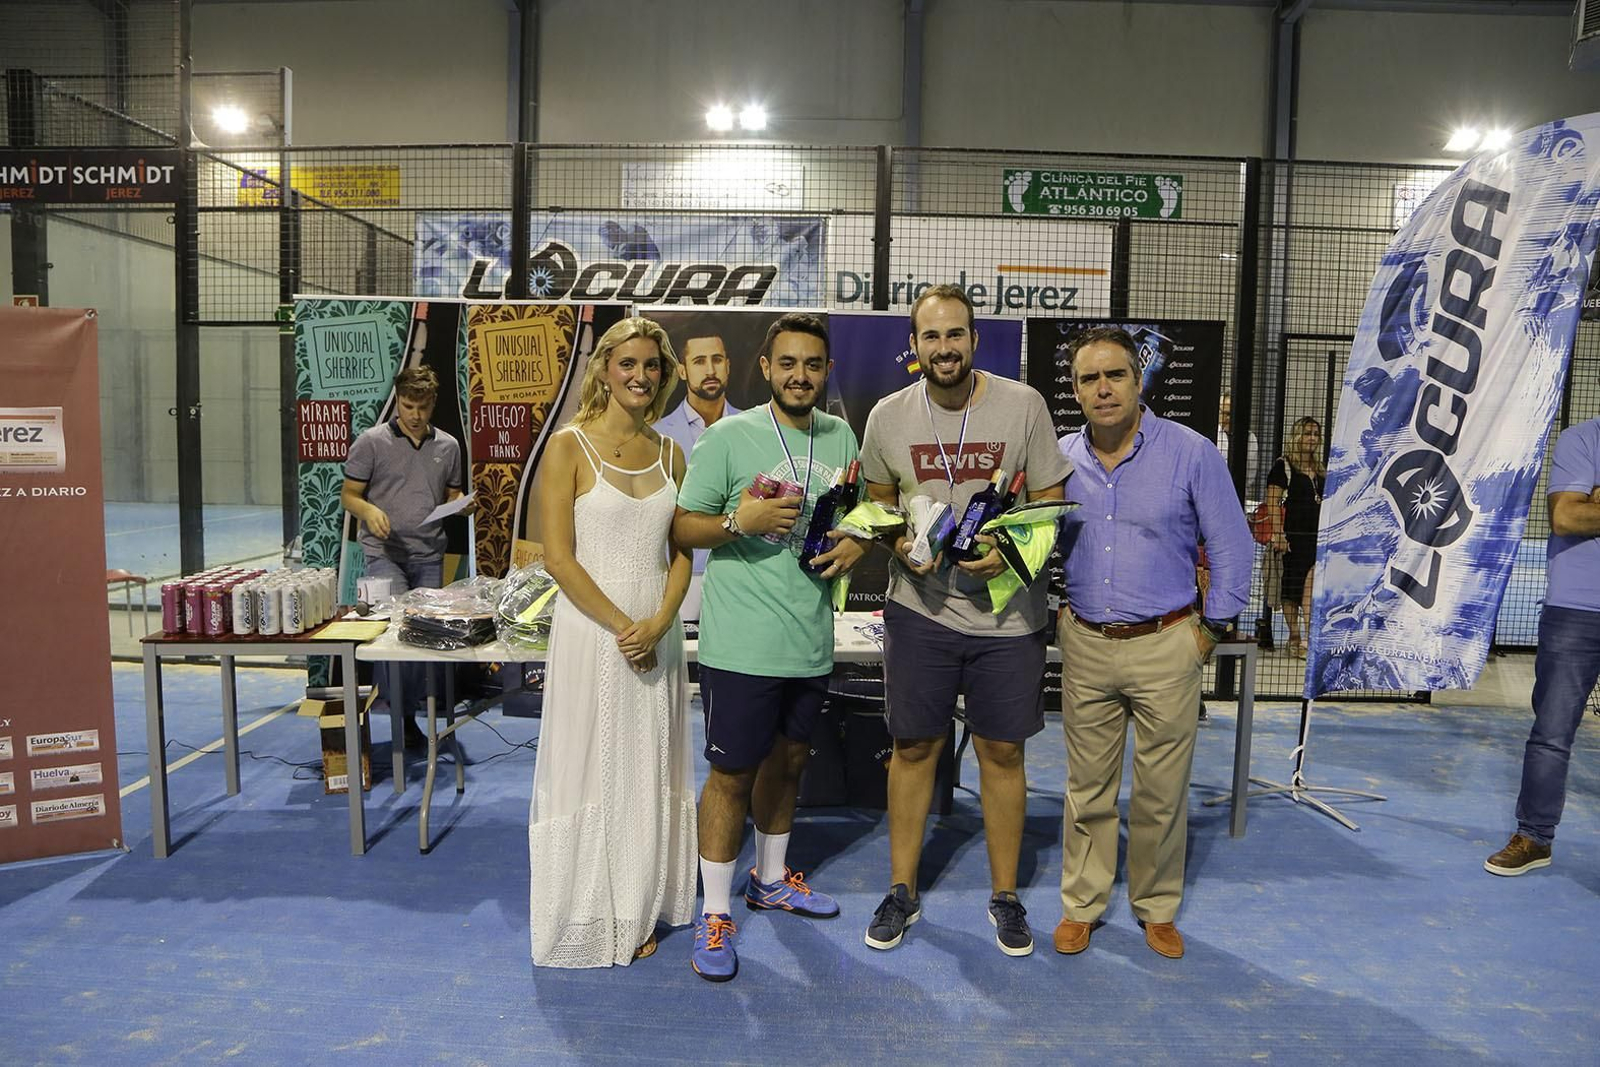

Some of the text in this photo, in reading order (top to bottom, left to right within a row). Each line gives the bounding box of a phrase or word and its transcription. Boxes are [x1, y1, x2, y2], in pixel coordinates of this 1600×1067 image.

[106, 187, 142, 200] JEREZ
[1039, 185, 1149, 203] ATLÁNTICO
[1064, 205, 1138, 217] 956 30 69 05
[463, 242, 778, 305] LOCURA
[836, 271, 933, 305] Dirio
[994, 275, 1078, 315] Jerez
[324, 329, 375, 354] UNUSUAL
[495, 333, 542, 357] UNUSUAL
[325, 357, 376, 380] SHERRIES
[496, 361, 544, 382] SHERRIES
[329, 387, 379, 398] BY ROMATE
[511, 390, 547, 399] ROMATE
[1382, 178, 1511, 610] LOCURA
[301, 401, 347, 423] MÍRAME
[473, 406, 526, 433] ¿FUEGO?
[302, 423, 347, 441] CUANDO
[498, 431, 510, 445] NO
[302, 441, 347, 458] TE HABLO
[489, 445, 521, 458] THANKS
[16, 488, 27, 497] A
[32, 487, 87, 497] DIARIO
[849, 593, 888, 602] PATROC
[34, 769, 69, 779] Huelva
